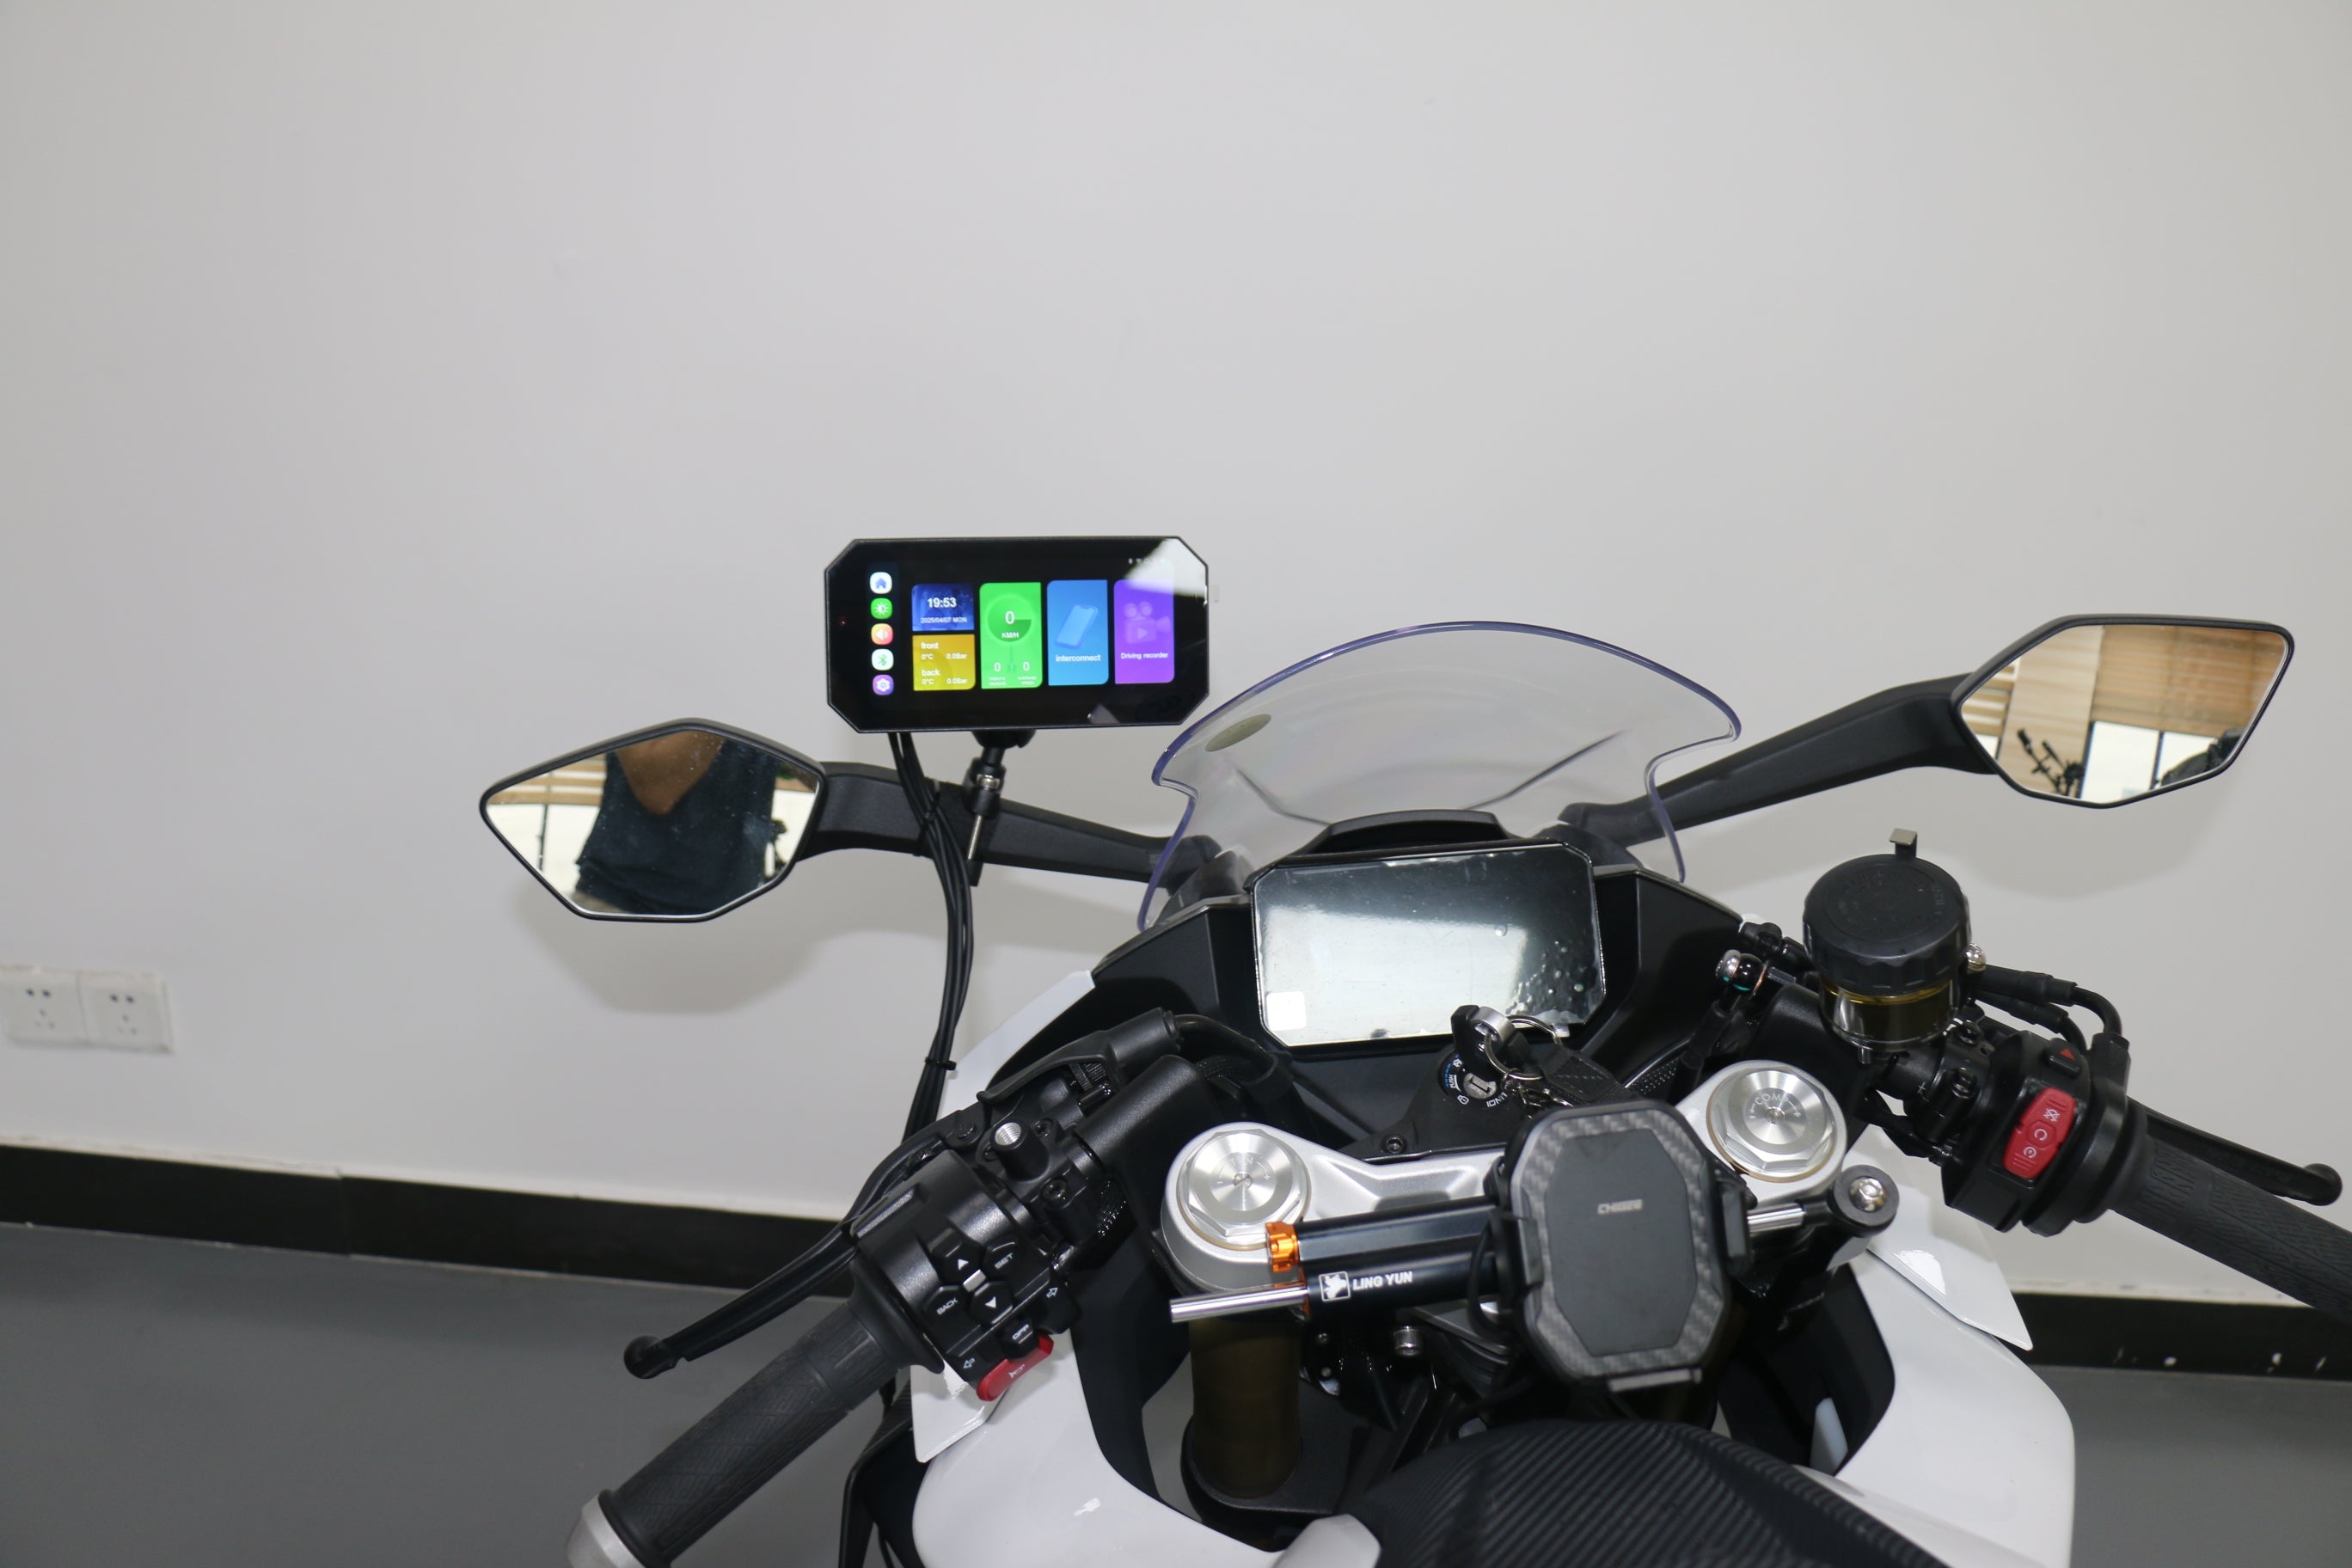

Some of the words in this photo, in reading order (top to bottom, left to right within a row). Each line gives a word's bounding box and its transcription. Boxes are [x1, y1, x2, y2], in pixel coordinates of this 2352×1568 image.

[928, 597, 957, 608] 19:53
[1005, 610, 1015, 625] 0
[921, 641, 940, 650] front
[1056, 653, 1101, 662] interconnect
[1120, 652, 1142, 660] Driving
[994, 662, 1001, 672] 0
[1022, 661, 1030, 671] 0
[1755, 1093, 1789, 1106] COMP
[994, 1253, 1013, 1270] SET
[1352, 1276, 1383, 1291] LING
[1385, 1271, 1413, 1285] YUN
[936, 1297, 959, 1315] BACK
